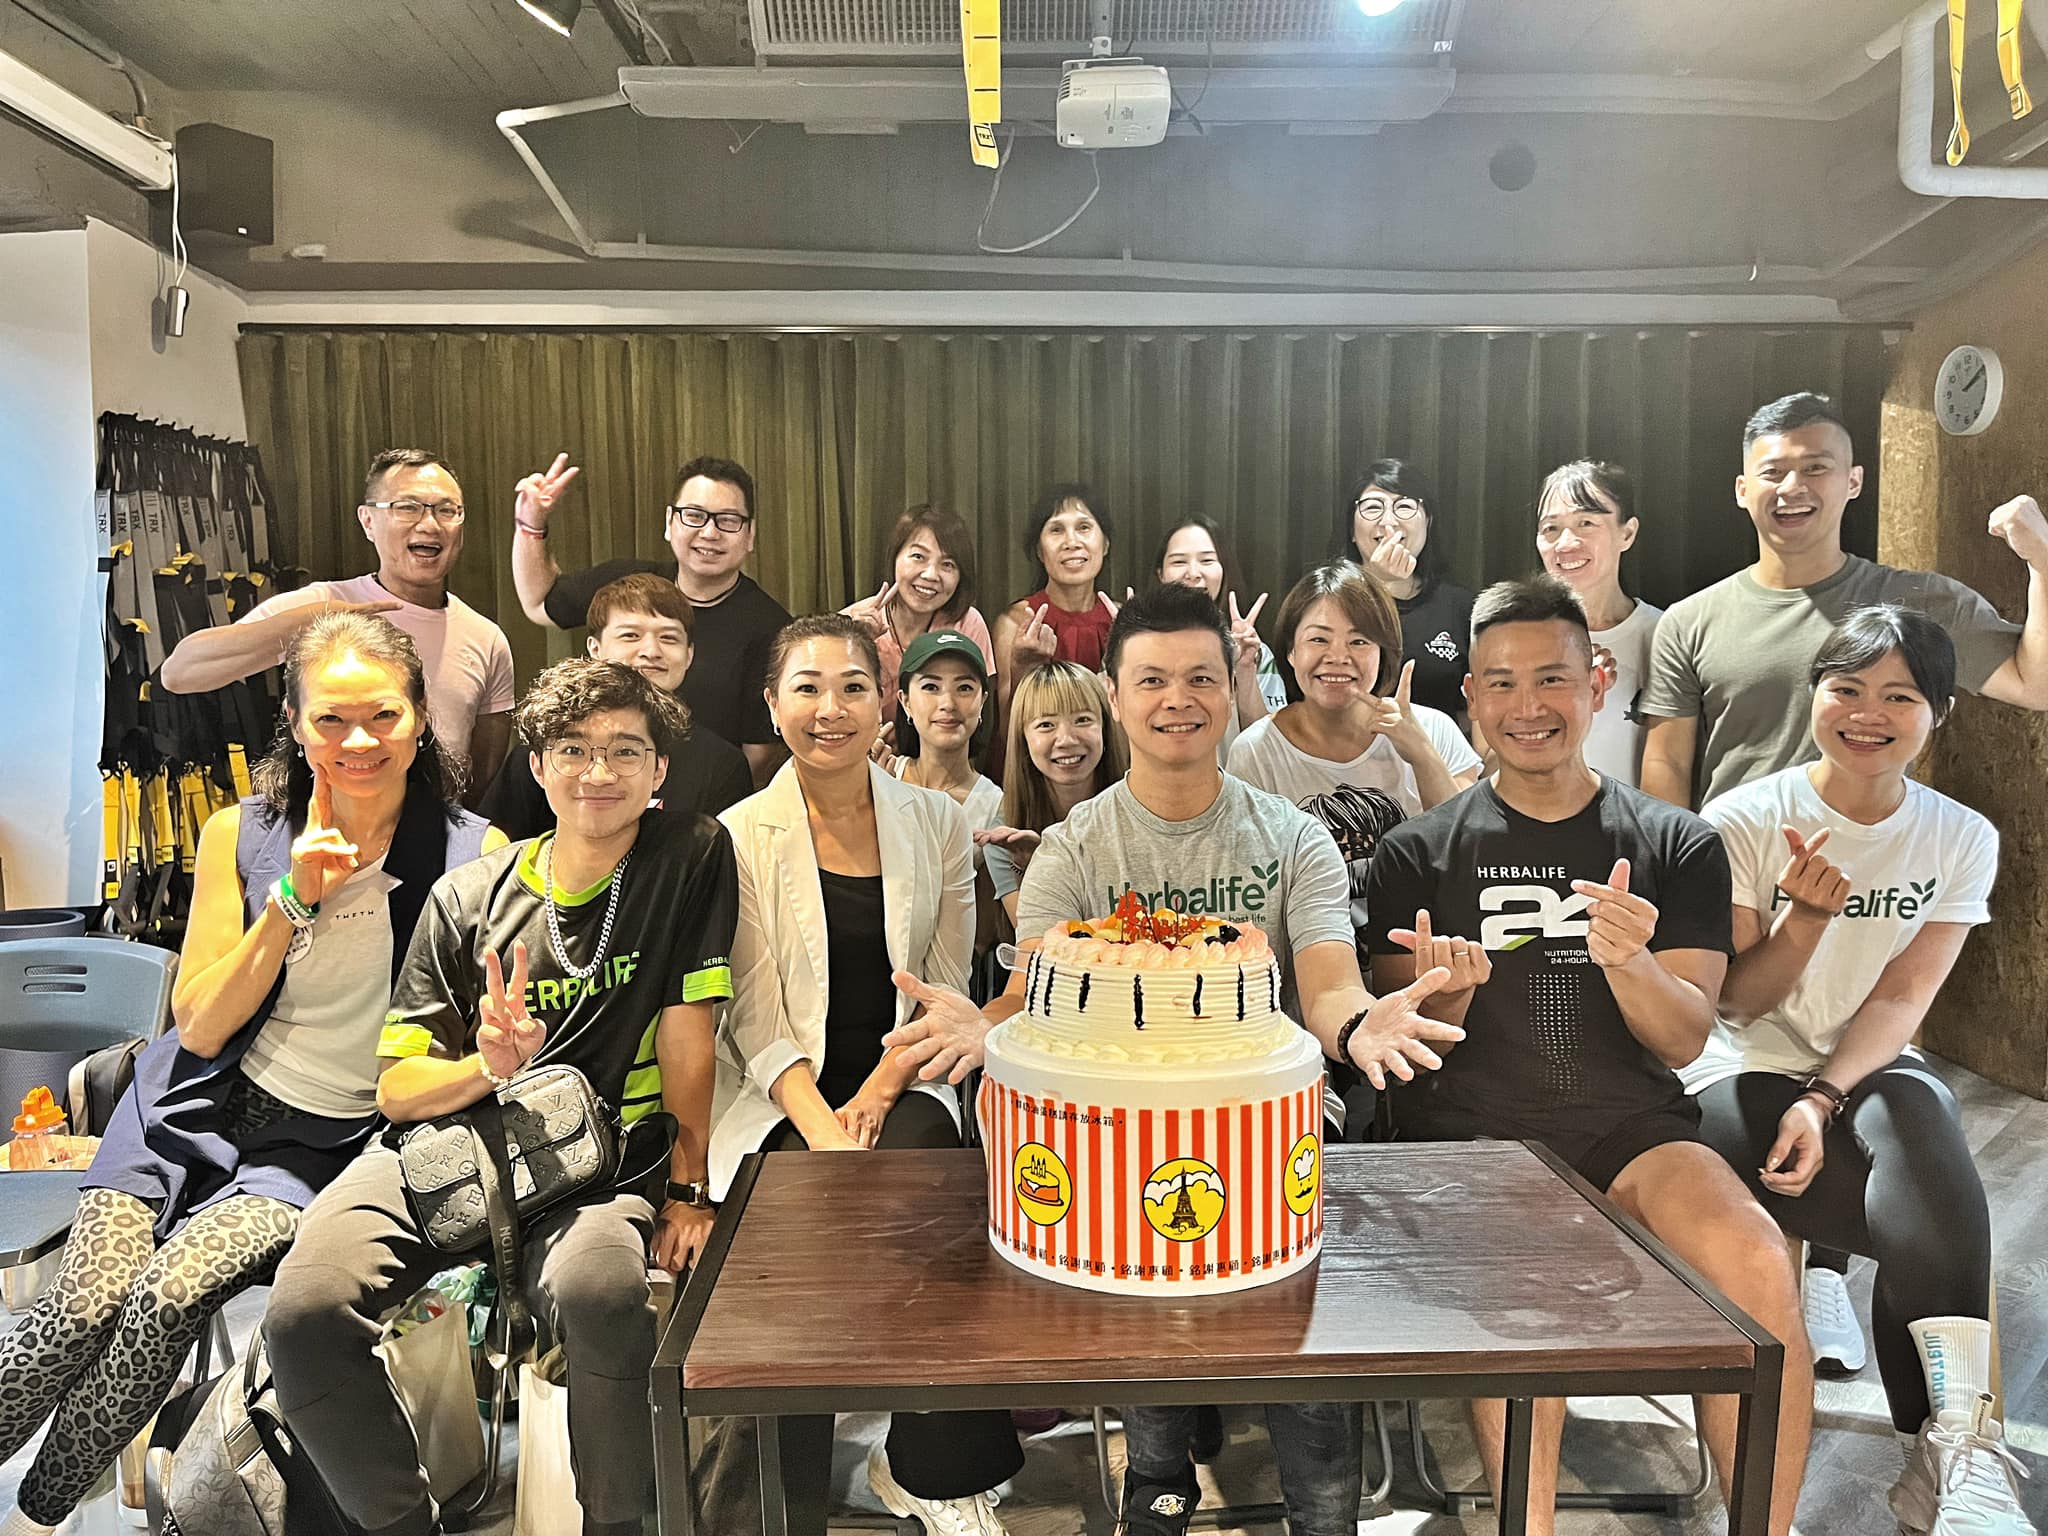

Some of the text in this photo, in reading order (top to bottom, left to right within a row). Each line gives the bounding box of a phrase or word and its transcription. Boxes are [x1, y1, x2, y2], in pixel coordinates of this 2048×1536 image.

[98, 512, 107, 533] TRX
[117, 512, 127, 532] TRX
[131, 510, 141, 529] TRX
[149, 513, 159, 533] TRX
[1266, 695, 1285, 706] TH
[1477, 866, 1567, 879] HERBALIFE
[1770, 884, 1918, 920] Halife
[1252, 912, 1266, 923] life
[506, 951, 640, 1012] ERBLIFE
[1922, 1331, 1944, 1368] JUST
[1931, 1372, 1944, 1392] DO
